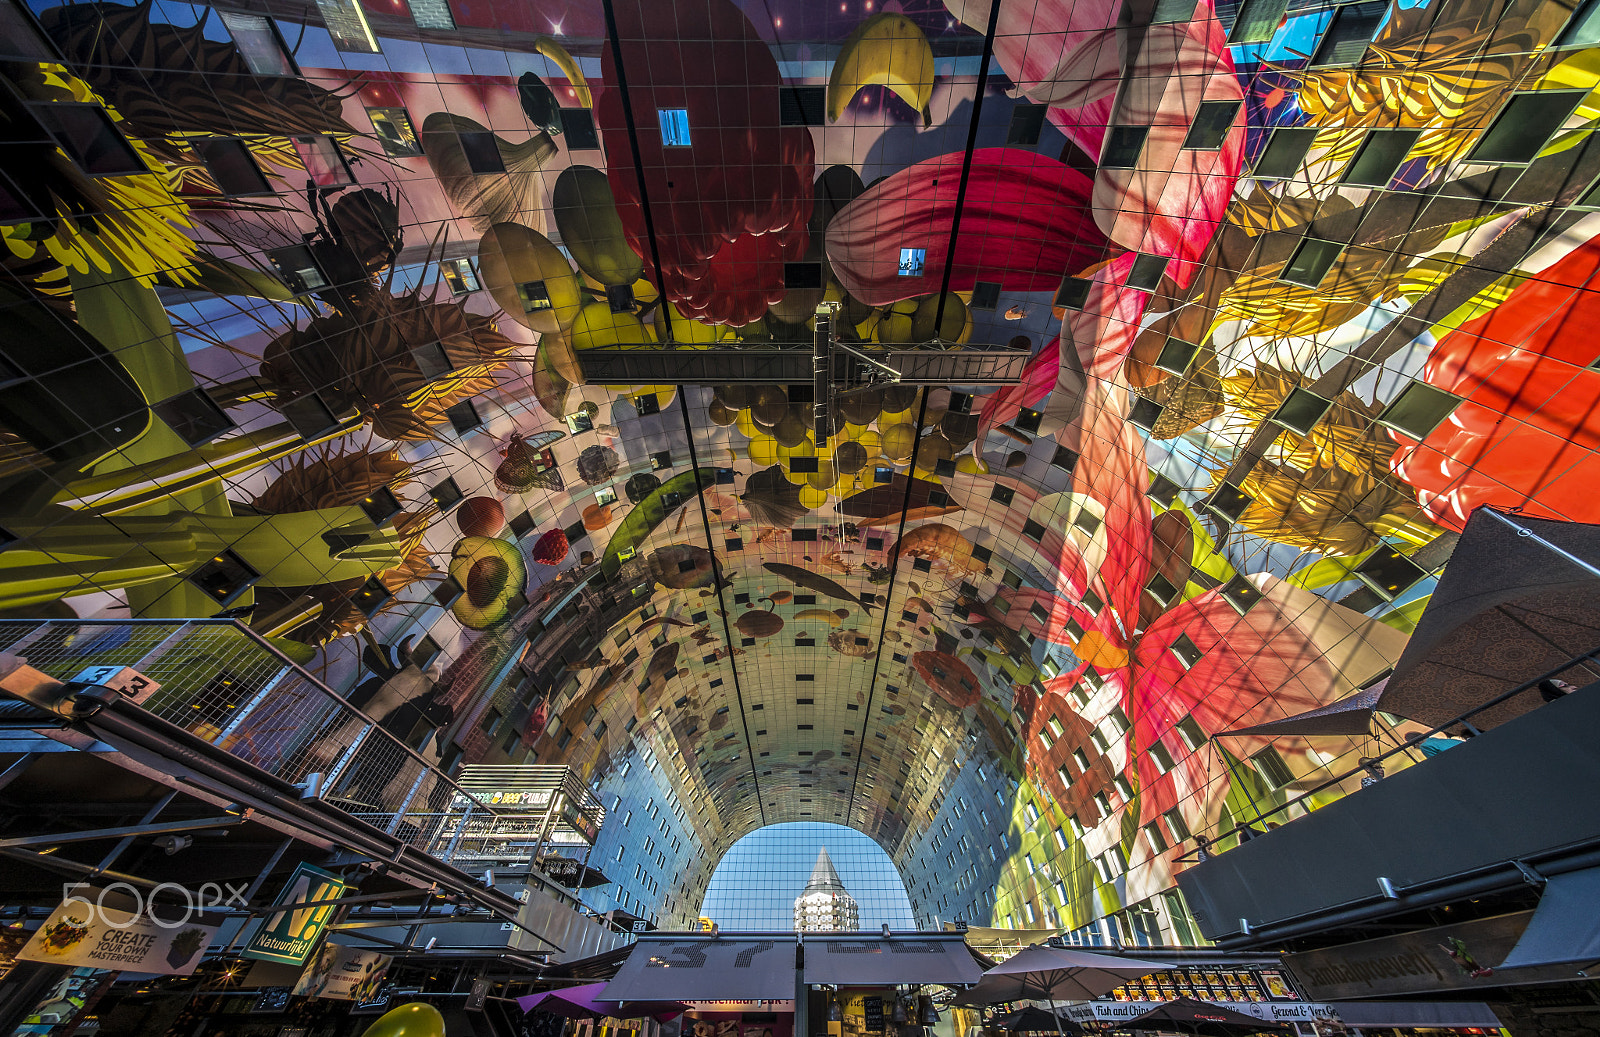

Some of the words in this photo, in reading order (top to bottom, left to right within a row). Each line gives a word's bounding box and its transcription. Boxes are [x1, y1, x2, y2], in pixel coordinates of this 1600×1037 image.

[633, 921, 646, 931] 37
[102, 928, 157, 948] CREATE
[256, 933, 308, 956] Natuurlijk!
[96, 940, 124, 953] YOUR
[123, 944, 151, 956] OWN
[87, 950, 145, 964] MASTERPIECE
[1095, 1005, 1113, 1016] Fish
[1113, 1005, 1129, 1016] and
[1271, 1005, 1299, 1019] Gezond
